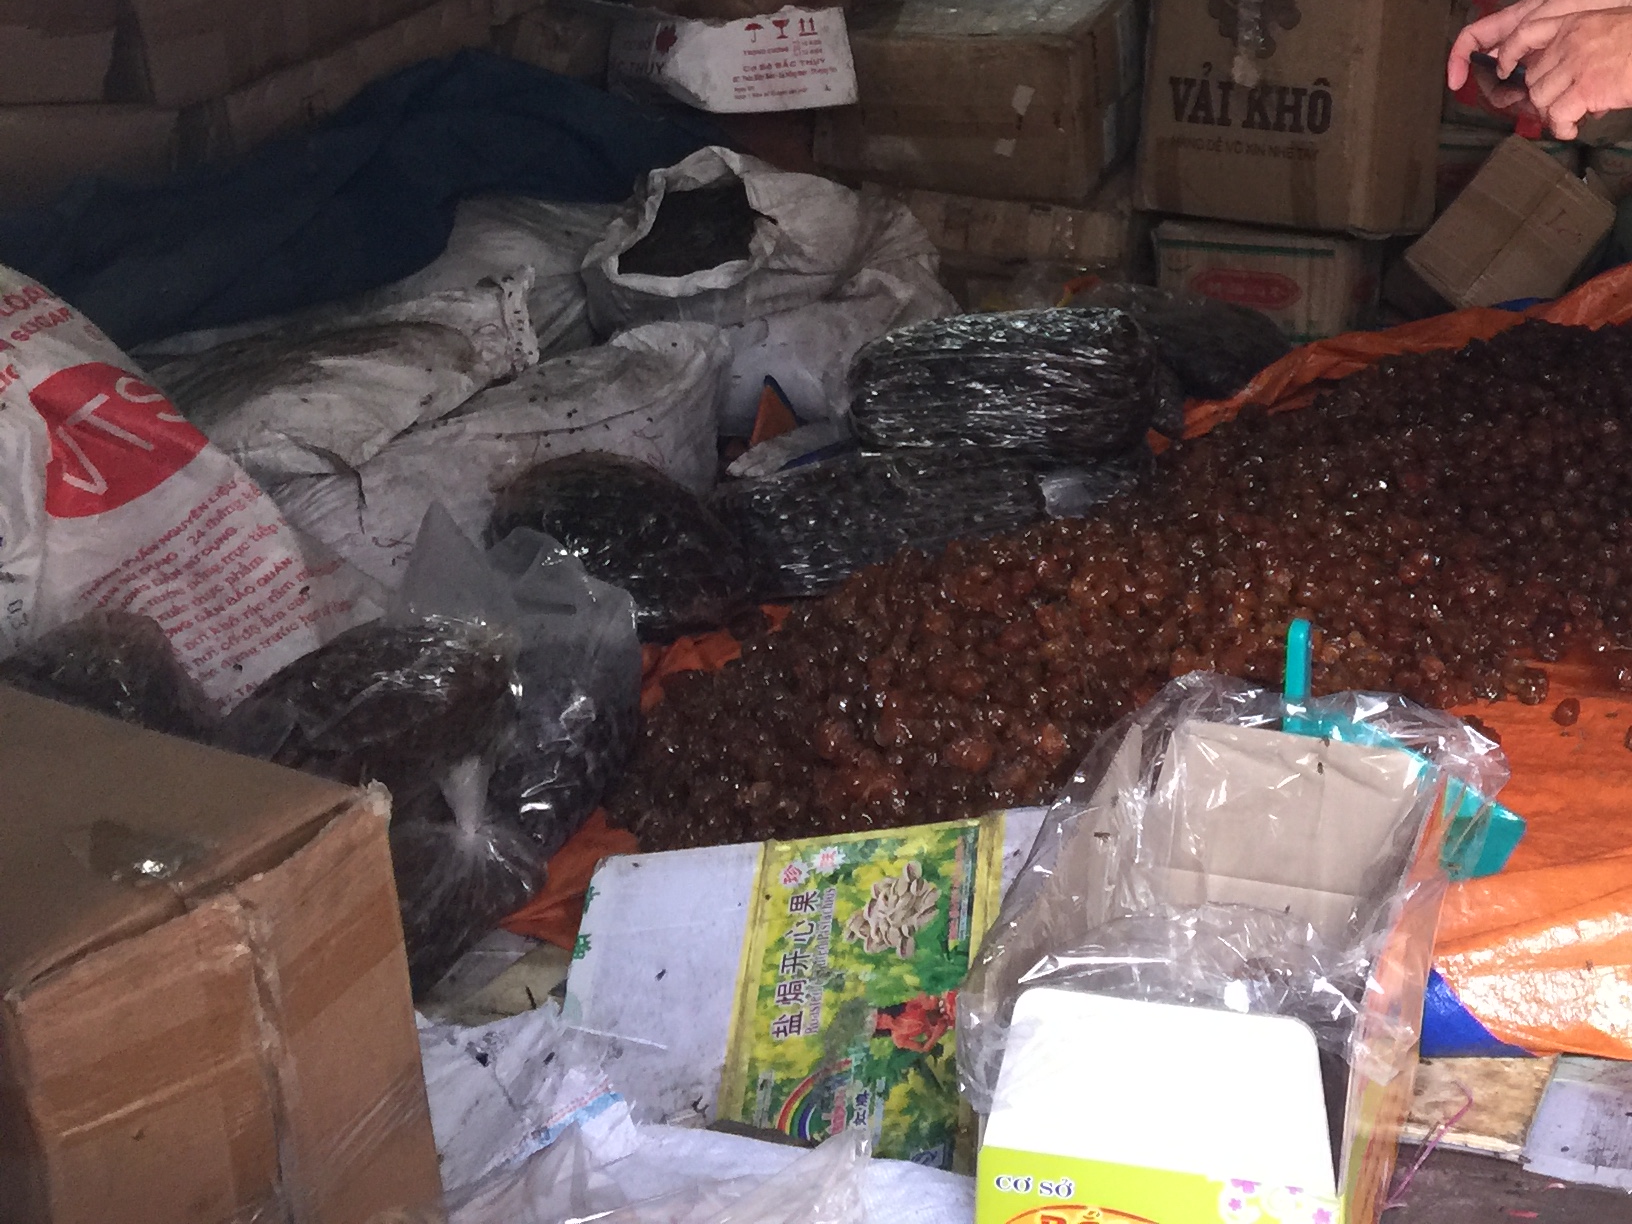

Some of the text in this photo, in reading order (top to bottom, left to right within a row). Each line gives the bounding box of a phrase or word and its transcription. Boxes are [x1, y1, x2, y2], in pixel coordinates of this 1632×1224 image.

[1168, 61, 1333, 135] VẢI KHÔ
[772, 890, 818, 1038] 盐焗开心果
[995, 1176, 1073, 1198] CƠ SỞ
